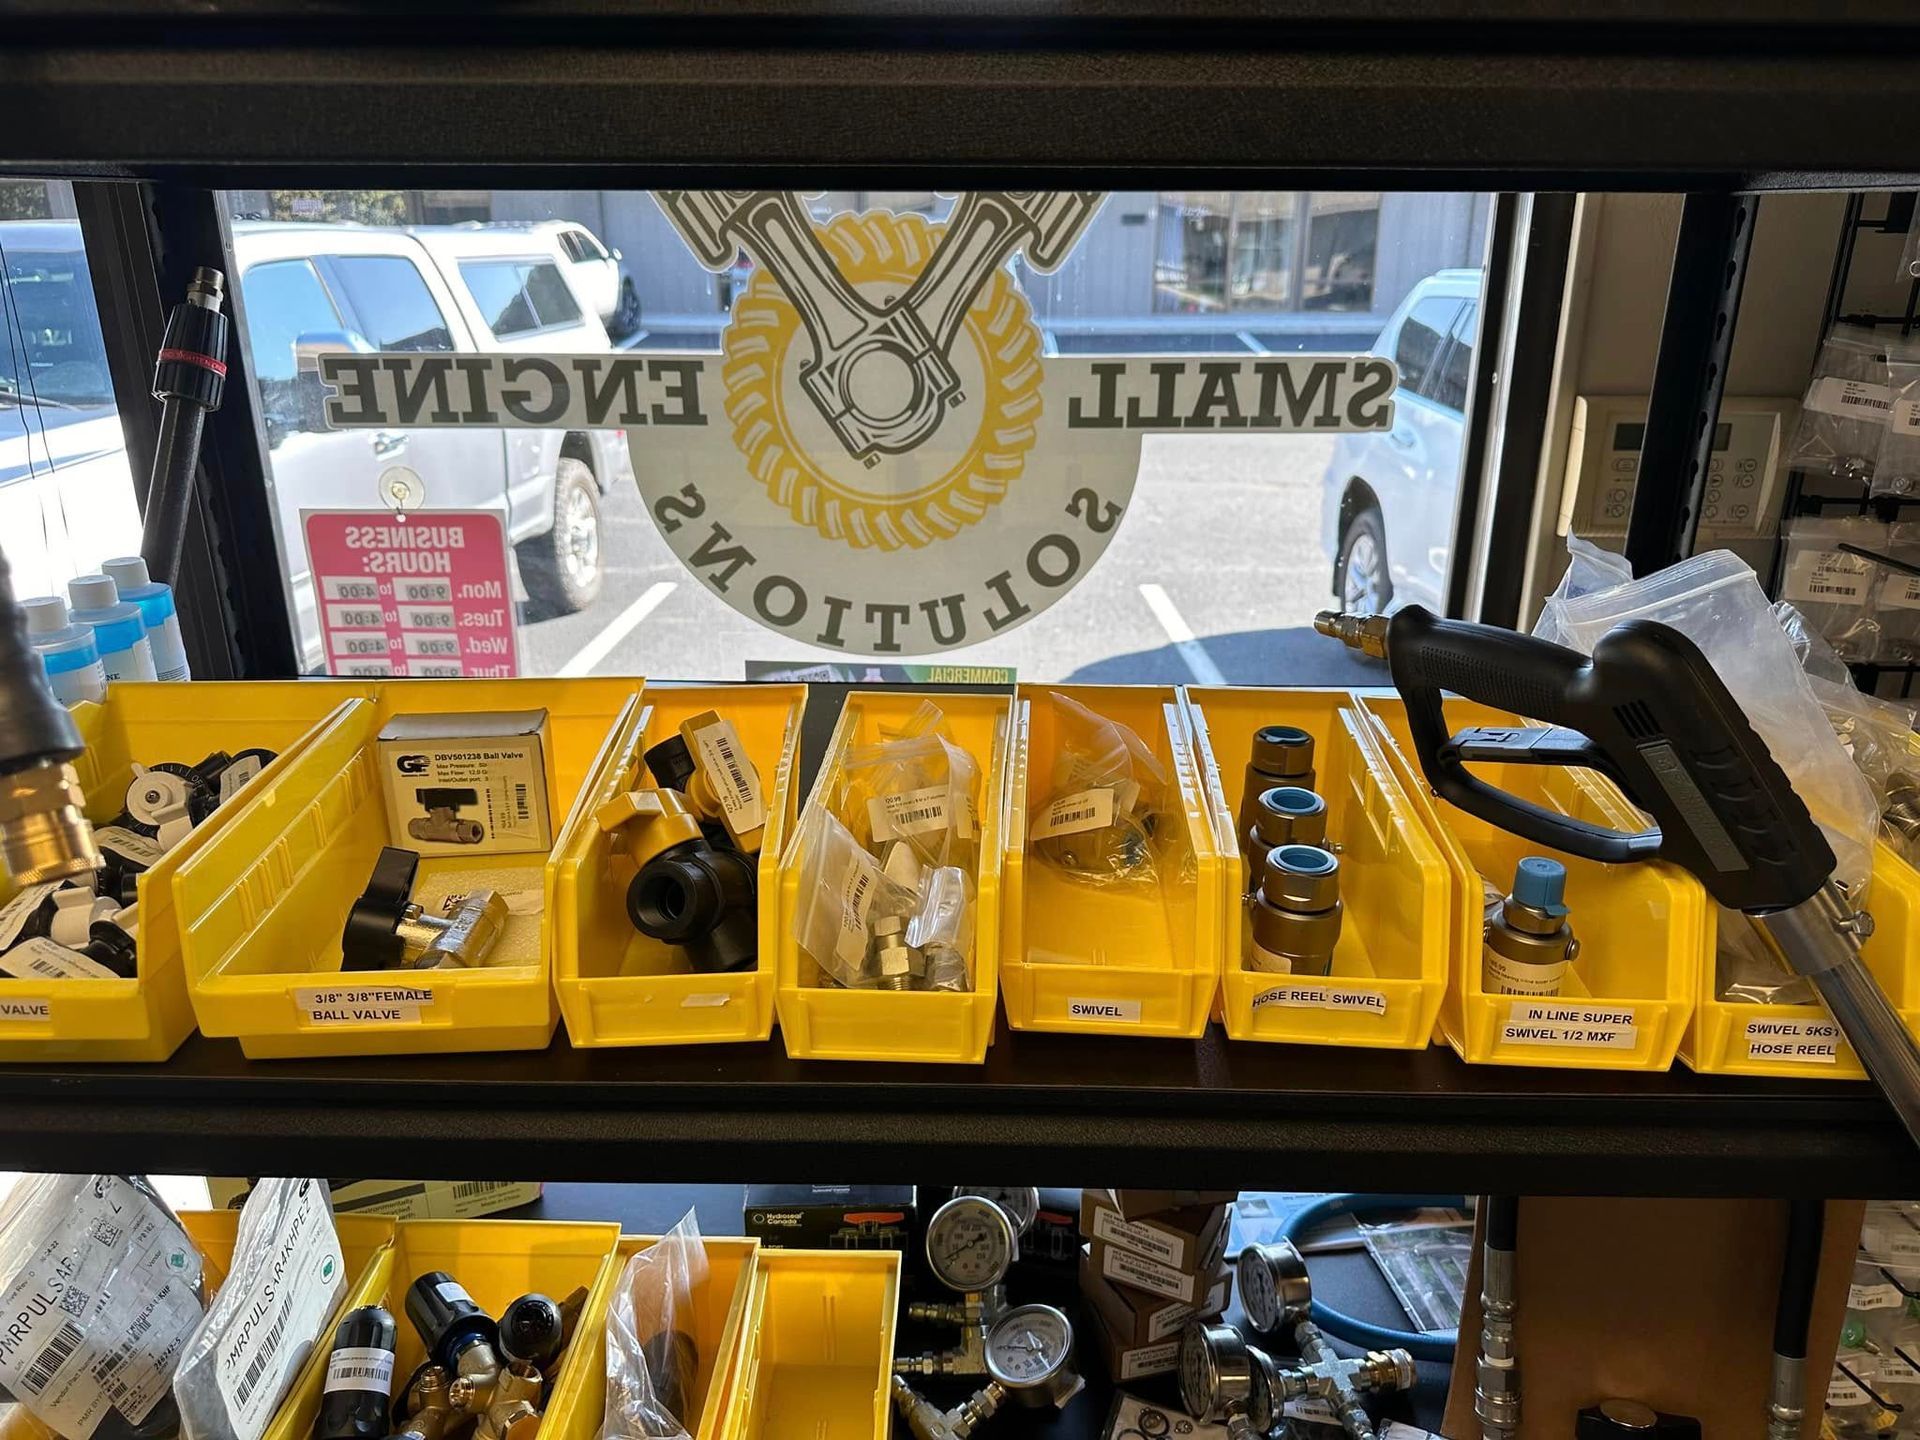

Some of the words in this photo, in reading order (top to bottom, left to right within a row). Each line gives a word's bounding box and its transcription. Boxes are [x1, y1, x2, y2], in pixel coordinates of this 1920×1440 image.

[484, 752, 499, 760] Ball
[1252, 991, 1287, 1007] HOSE
[1291, 991, 1327, 1001] REEL
[1332, 994, 1384, 1008] SWIVEL
[1, 1004, 49, 1015] VALVE
[313, 1010, 349, 1020] BALL
[353, 1010, 401, 1020] VALVE
[1072, 1004, 1122, 1017] SWIVEL
[1528, 1009, 1543, 1020] IN
[1547, 1010, 1579, 1021] LINE
[1583, 1012, 1632, 1025] SUPER
[1505, 1027, 1557, 1039] SWIVEL
[1562, 1030, 1583, 1041] 1/2
[1587, 1031, 1616, 1042] MXF
[1747, 1024, 1800, 1036] SWIVEL
[1750, 1044, 1793, 1054] HOSE
[1797, 1044, 1836, 1055] REEL
[766, 1212, 802, 1220] Hydroseal
